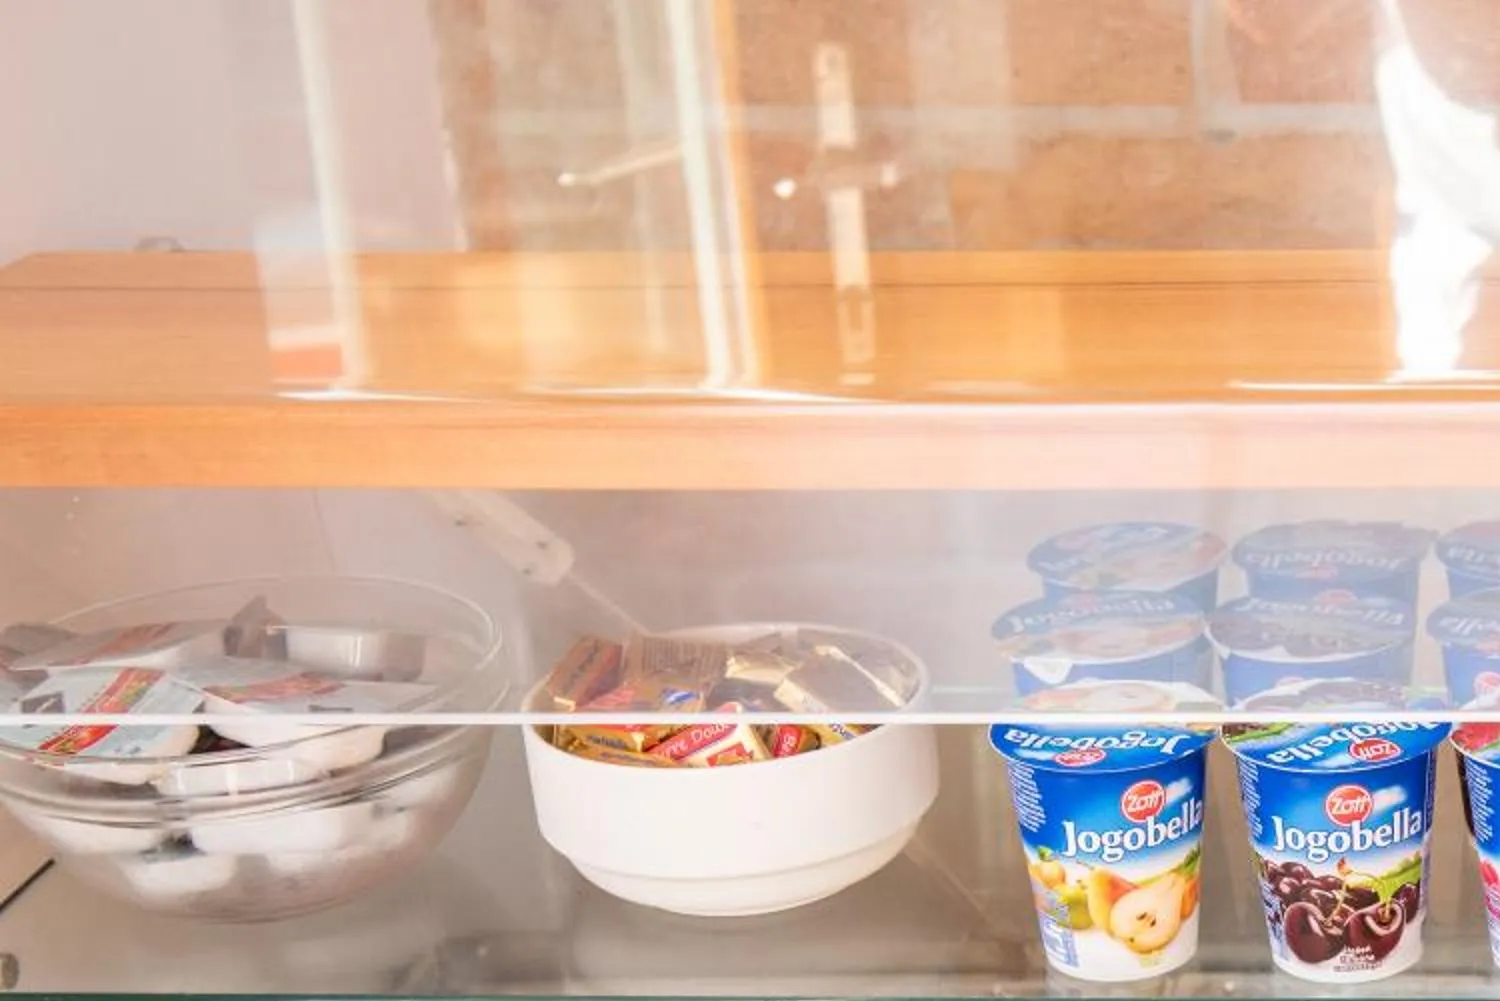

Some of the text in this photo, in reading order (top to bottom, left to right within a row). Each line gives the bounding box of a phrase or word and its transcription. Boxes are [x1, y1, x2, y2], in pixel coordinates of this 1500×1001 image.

[1004, 728, 1191, 754] Jogobella
[1126, 788, 1163, 813] Zott
[1331, 794, 1370, 815] Zott
[1271, 807, 1422, 863] Jogobella
